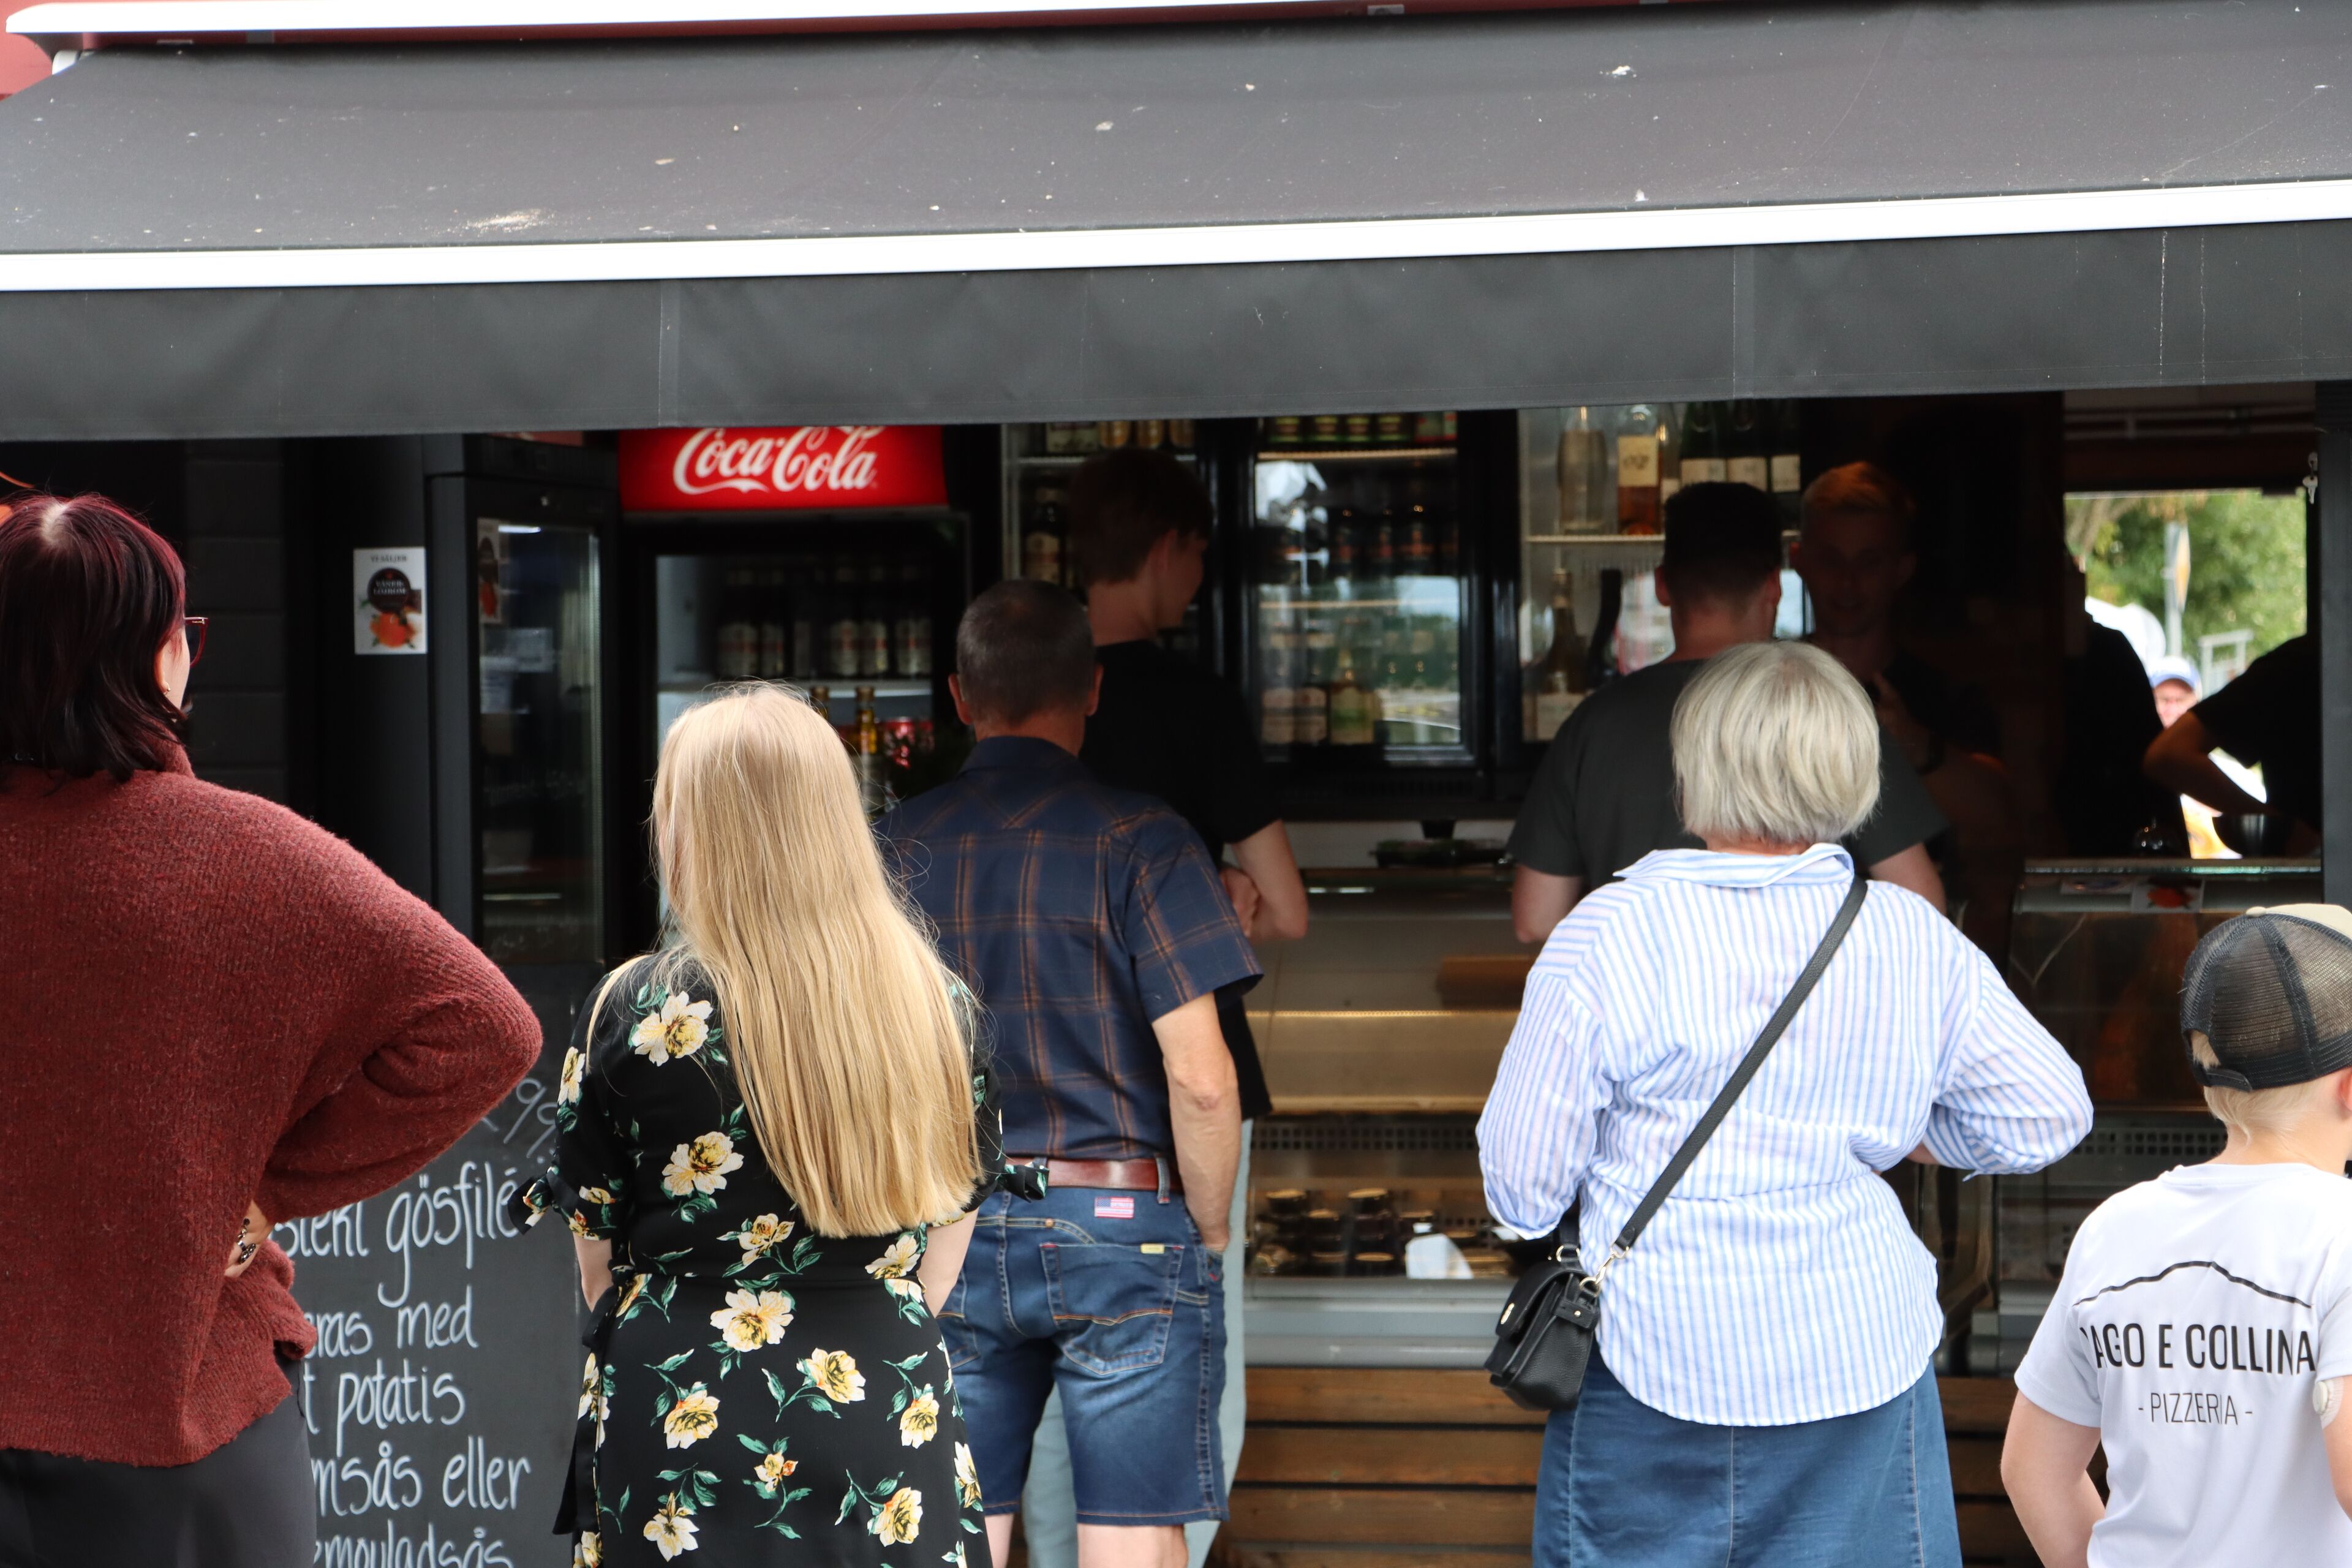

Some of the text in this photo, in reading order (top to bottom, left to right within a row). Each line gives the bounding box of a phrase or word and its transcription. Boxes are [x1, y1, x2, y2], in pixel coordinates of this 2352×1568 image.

[673, 426, 888, 495] Coca-Cola
[377, 1160, 519, 1308] gösfilé
[397, 1284, 479, 1349] med
[2080, 1322, 2316, 1376] AGO E COLLINA
[336, 1357, 466, 1459] potatis
[2150, 1392, 2239, 1425] PIZZERIA
[442, 1434, 532, 1510] eller
